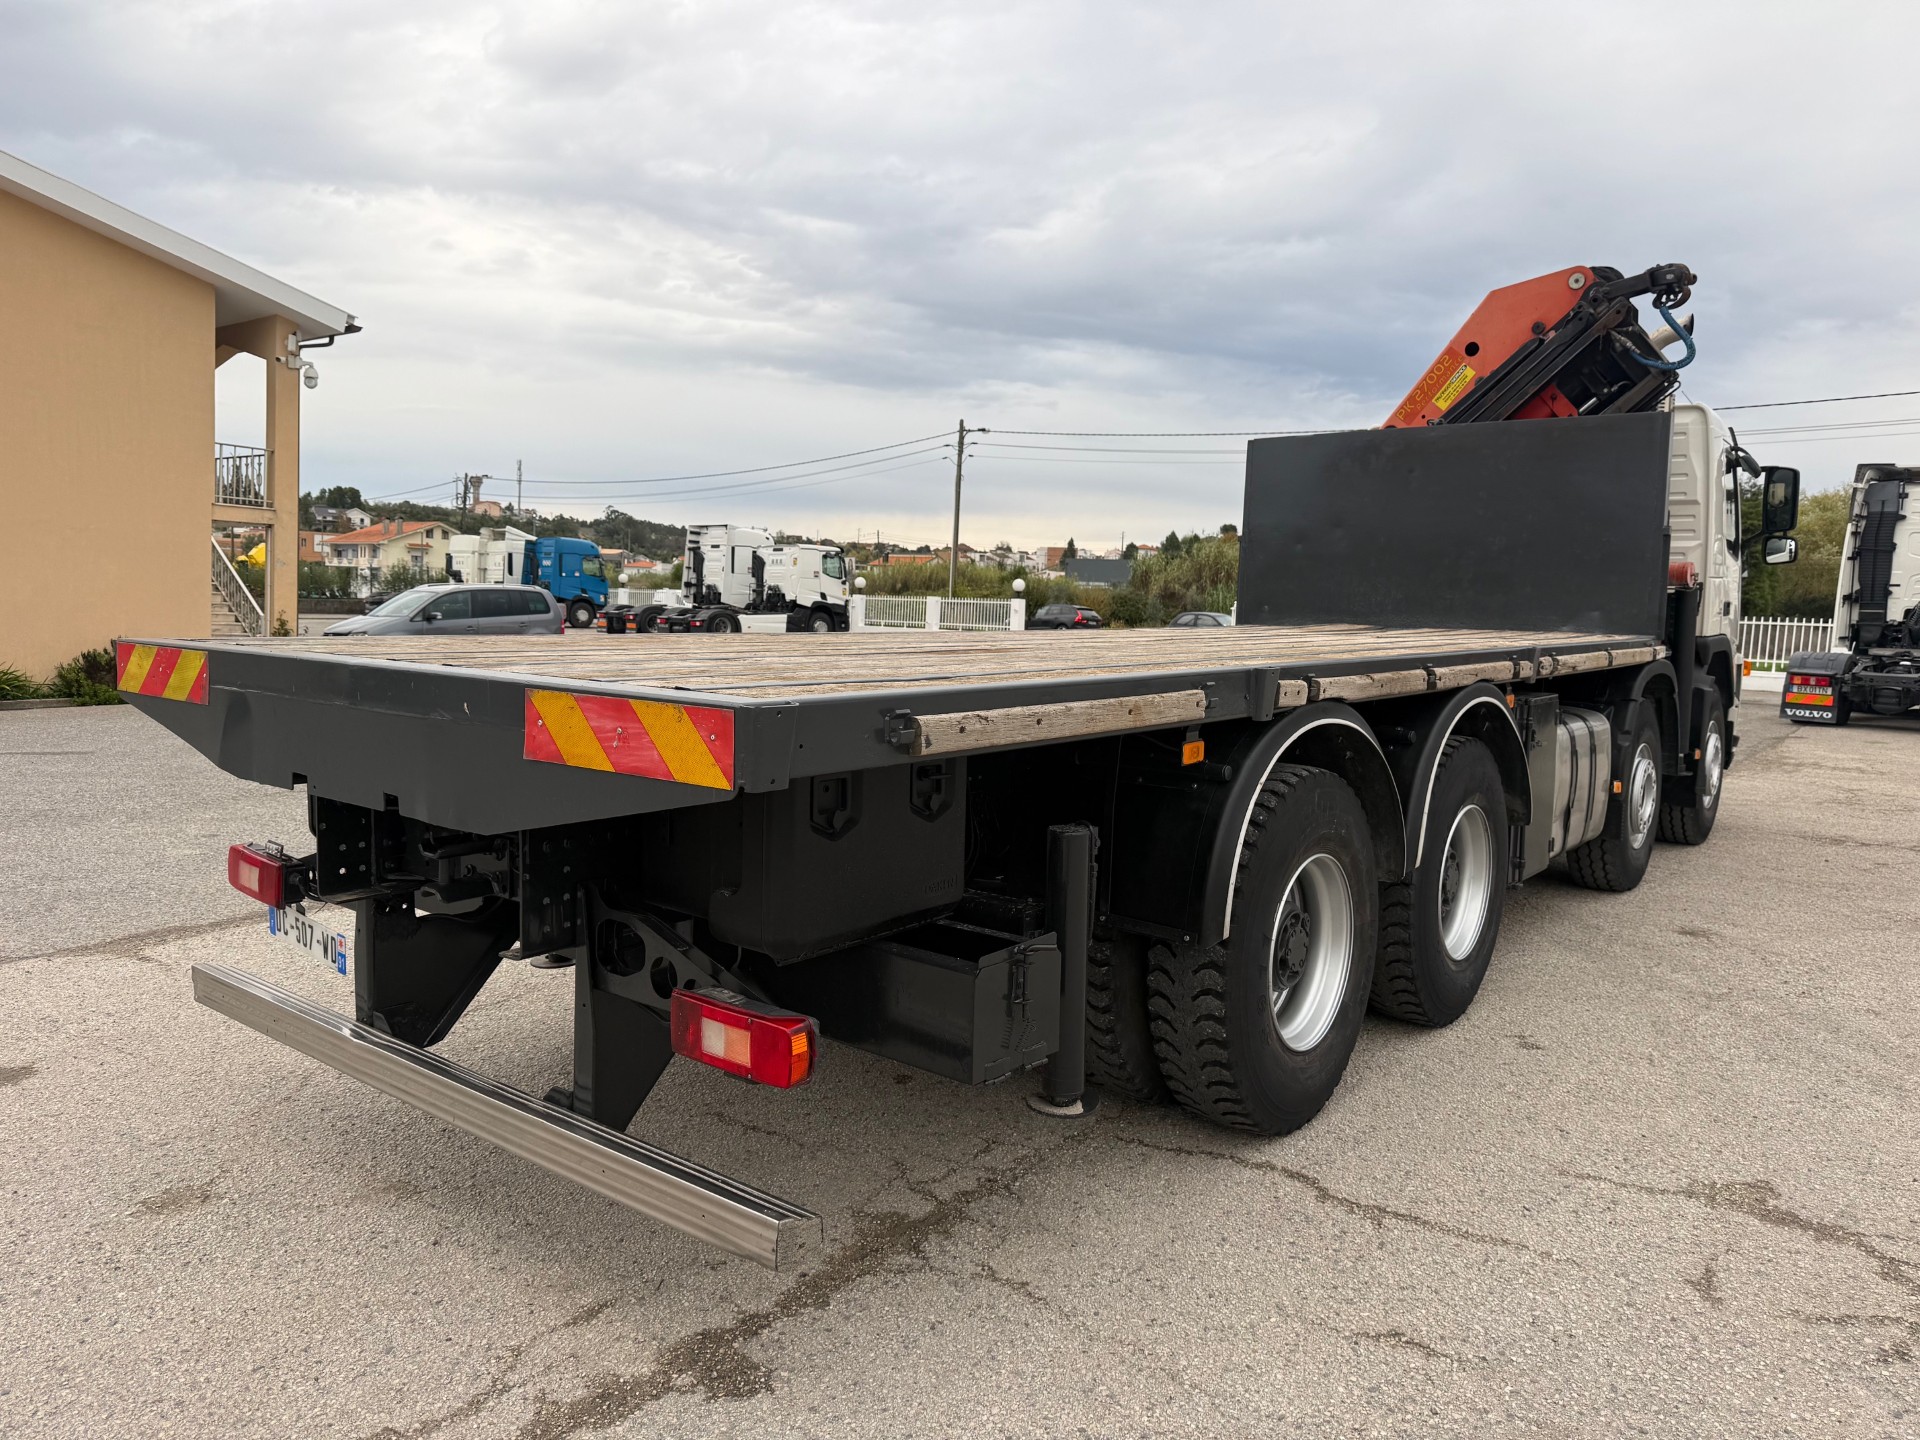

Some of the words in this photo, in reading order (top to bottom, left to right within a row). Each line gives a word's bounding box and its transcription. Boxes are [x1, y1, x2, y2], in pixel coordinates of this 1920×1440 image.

[1396, 401, 1414, 420] PK
[1412, 355, 1452, 401] 27002
[1416, 356, 1463, 410] Performance
[1785, 708, 1832, 719] VOLVO
